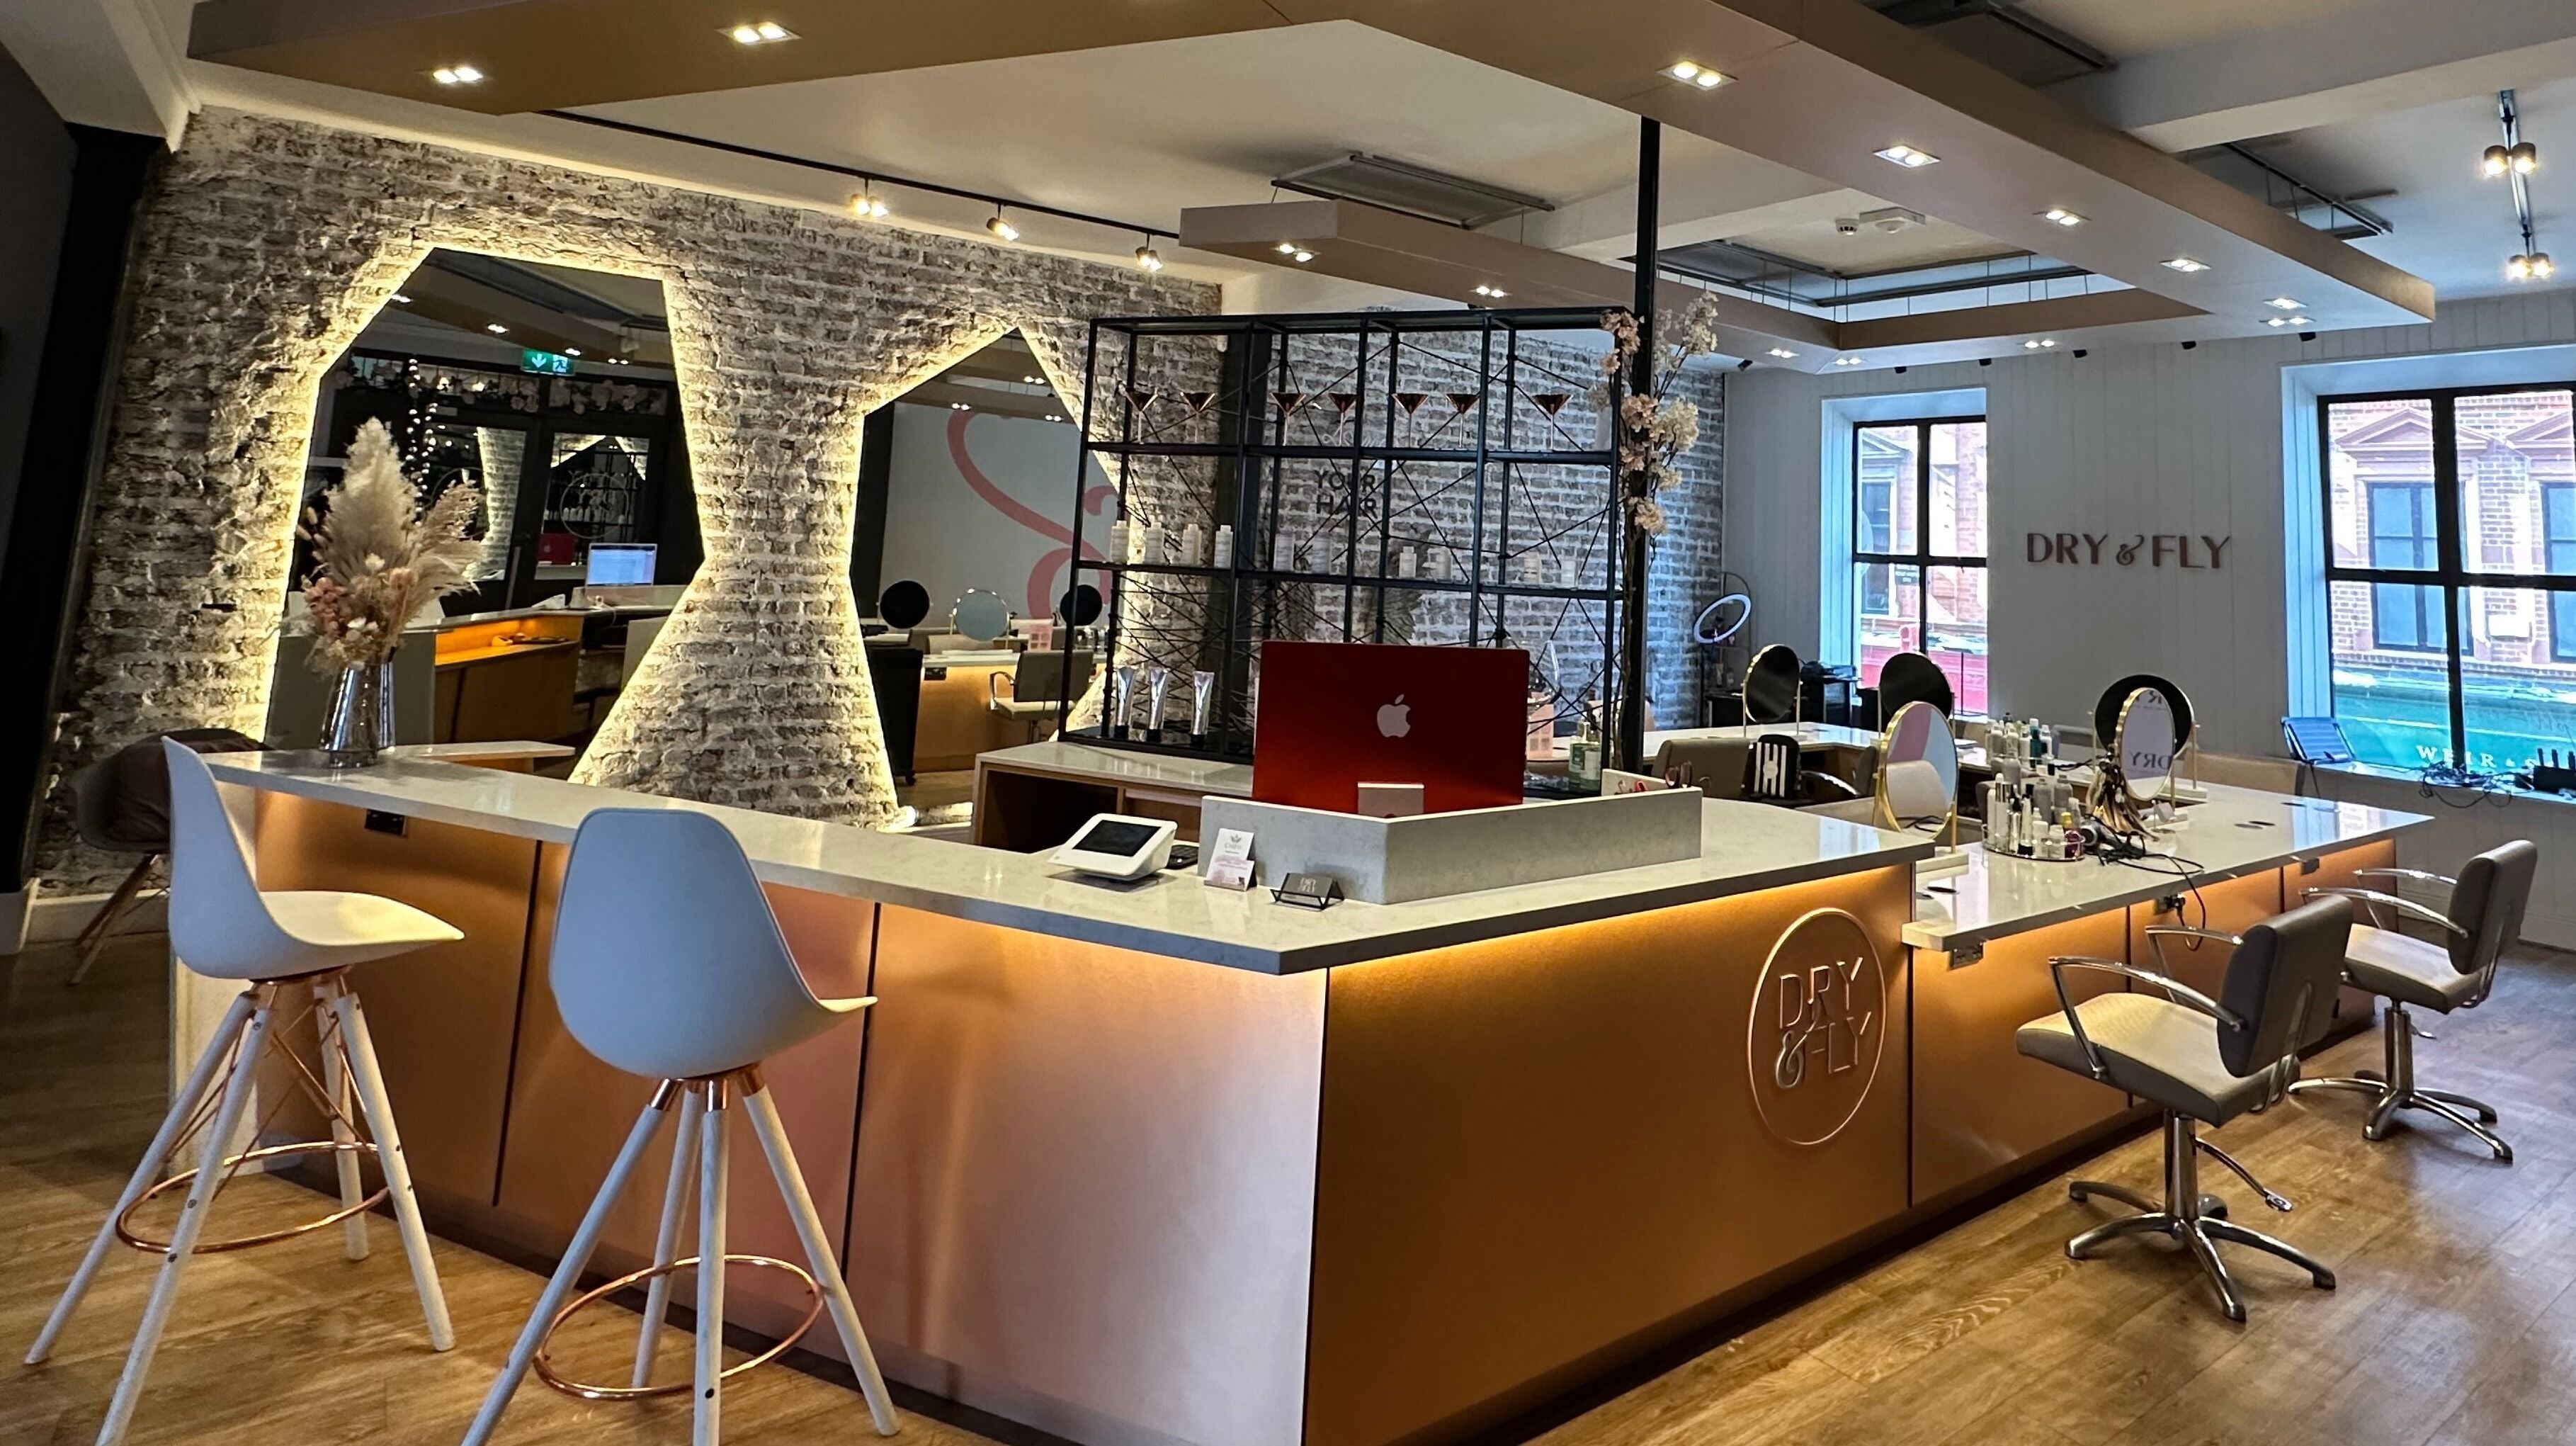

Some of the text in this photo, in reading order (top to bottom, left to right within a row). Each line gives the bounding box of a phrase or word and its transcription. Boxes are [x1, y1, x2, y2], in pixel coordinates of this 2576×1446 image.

[1317, 495, 1378, 519] HAR
[2026, 532, 2231, 570] DRY & FLY
[1779, 956, 1863, 1029] DRY
